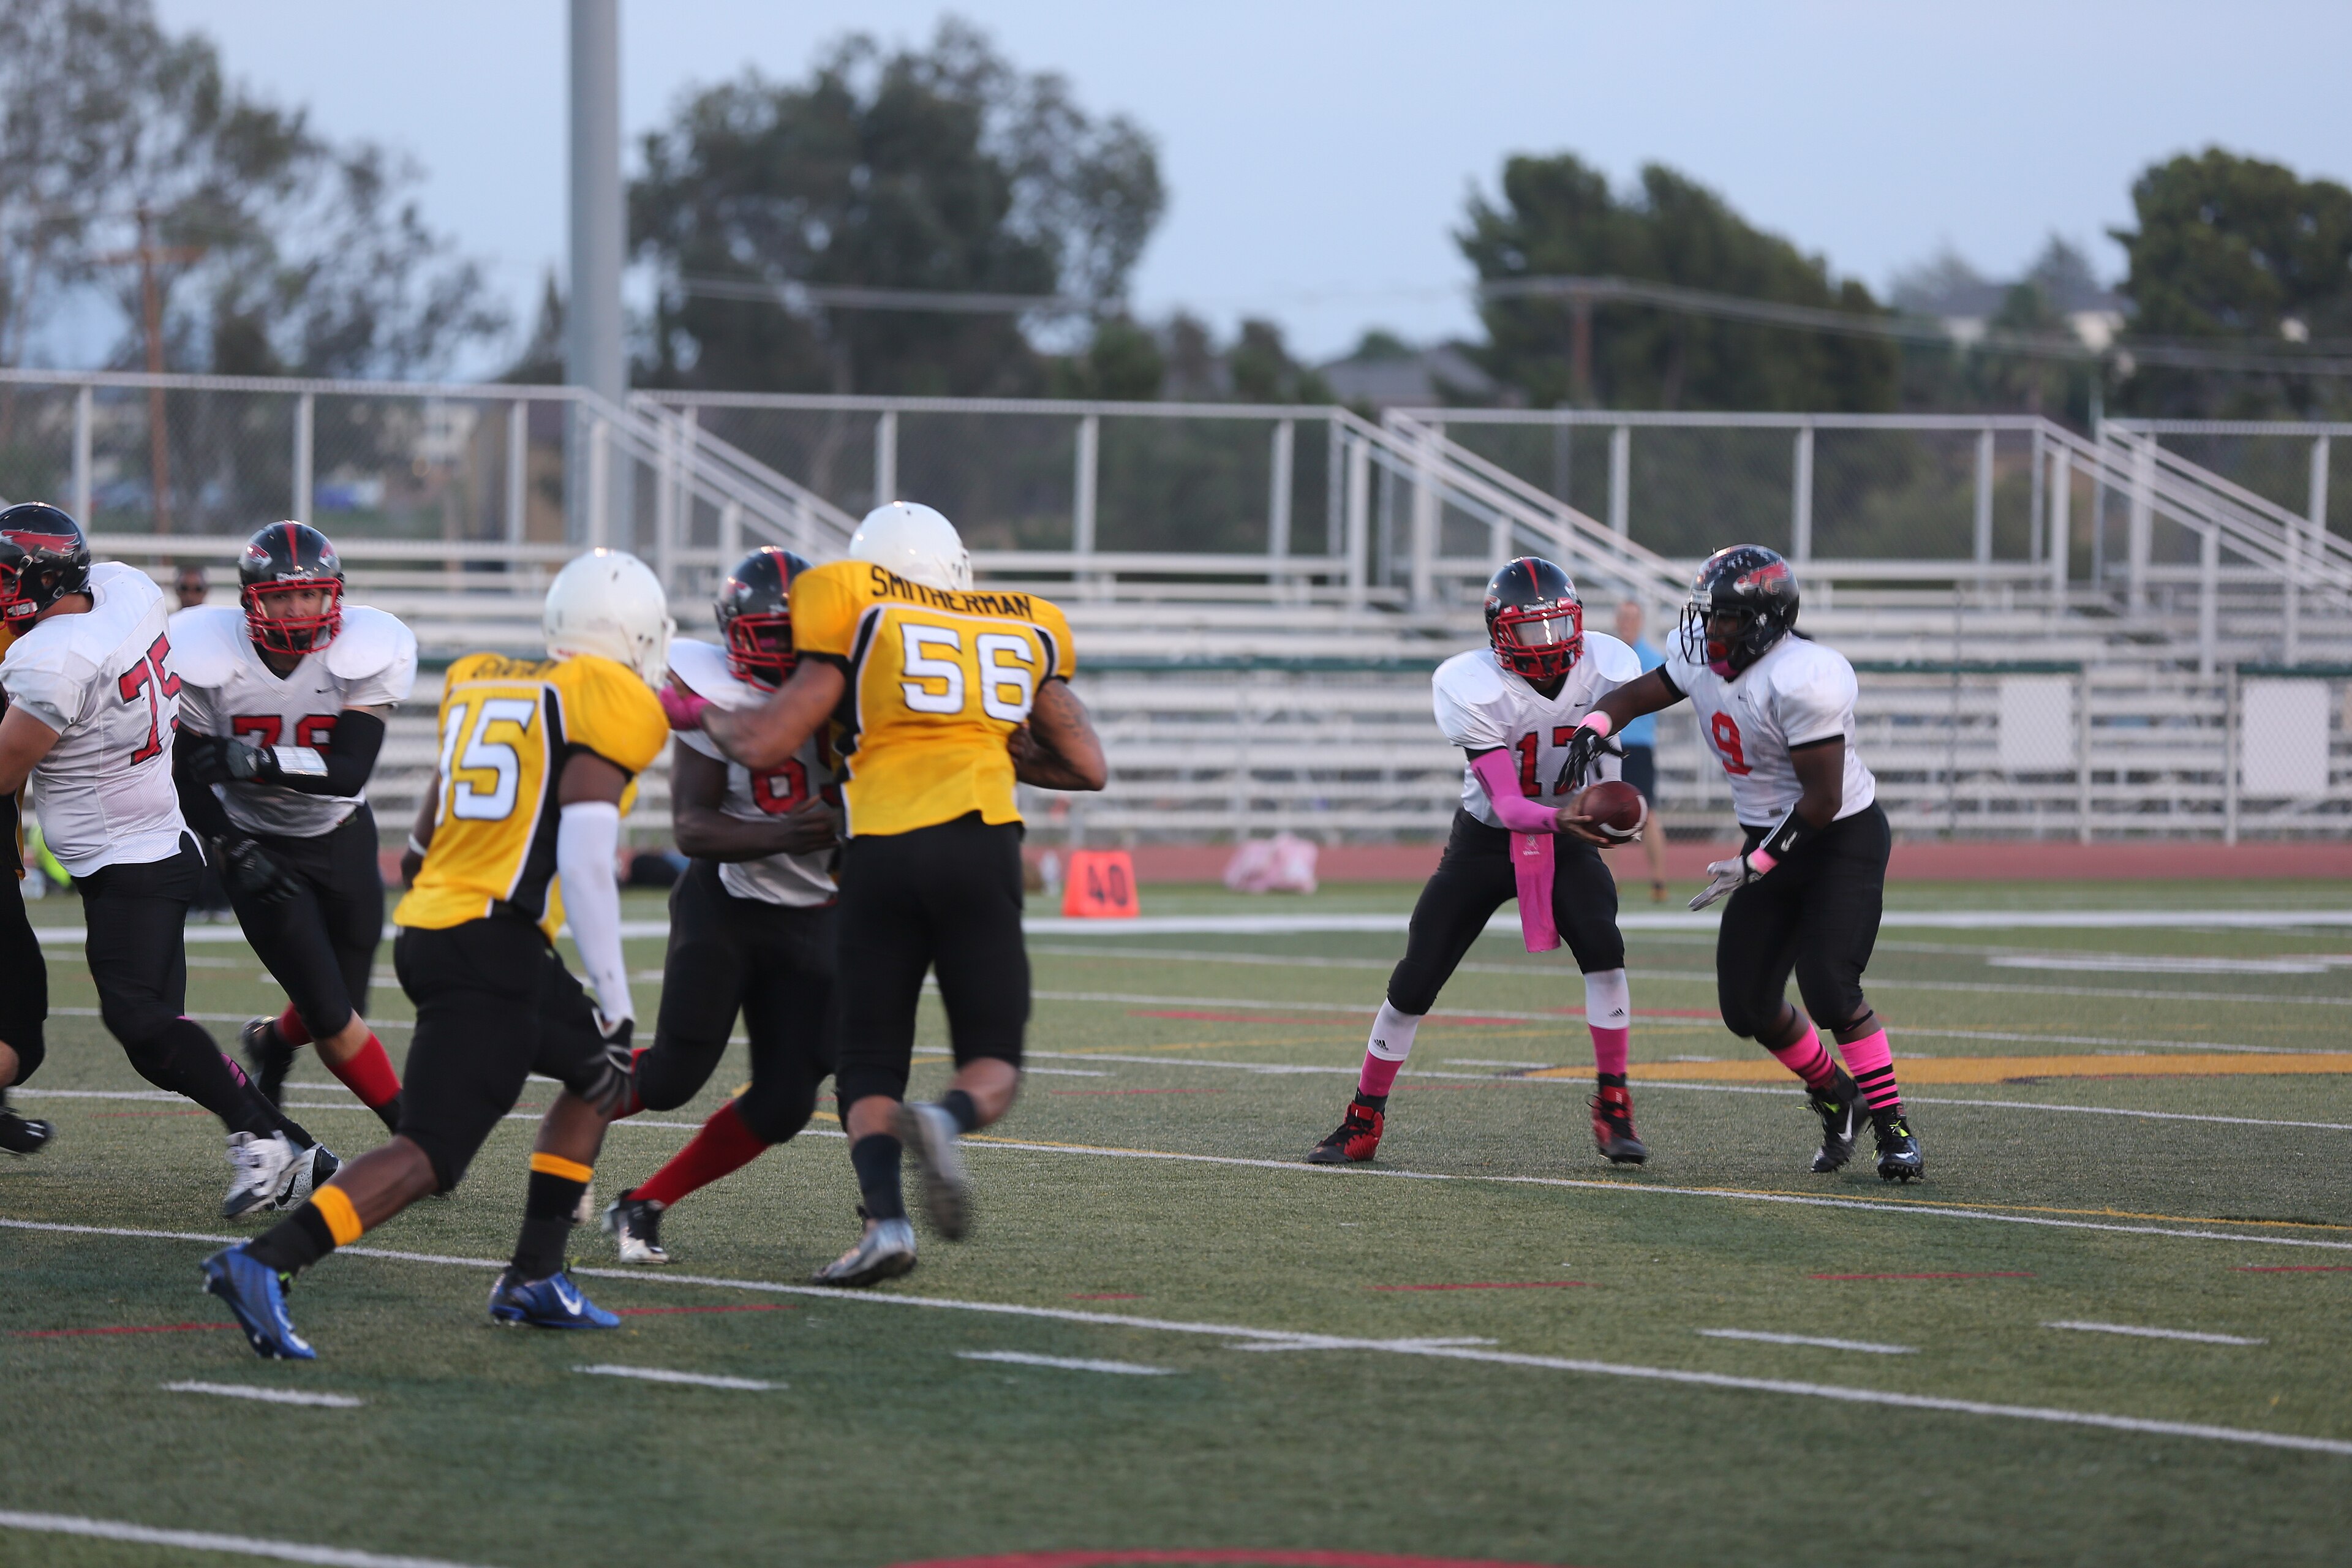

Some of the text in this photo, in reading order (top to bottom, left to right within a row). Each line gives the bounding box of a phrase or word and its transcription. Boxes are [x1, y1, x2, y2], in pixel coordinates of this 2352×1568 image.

[870, 564, 1034, 622] SMITHERMAN
[118, 631, 182, 766] 75
[899, 622, 1035, 725] 56
[434, 697, 537, 827] 15
[1711, 709, 1753, 776] 9
[1087, 864, 1129, 907] 40
